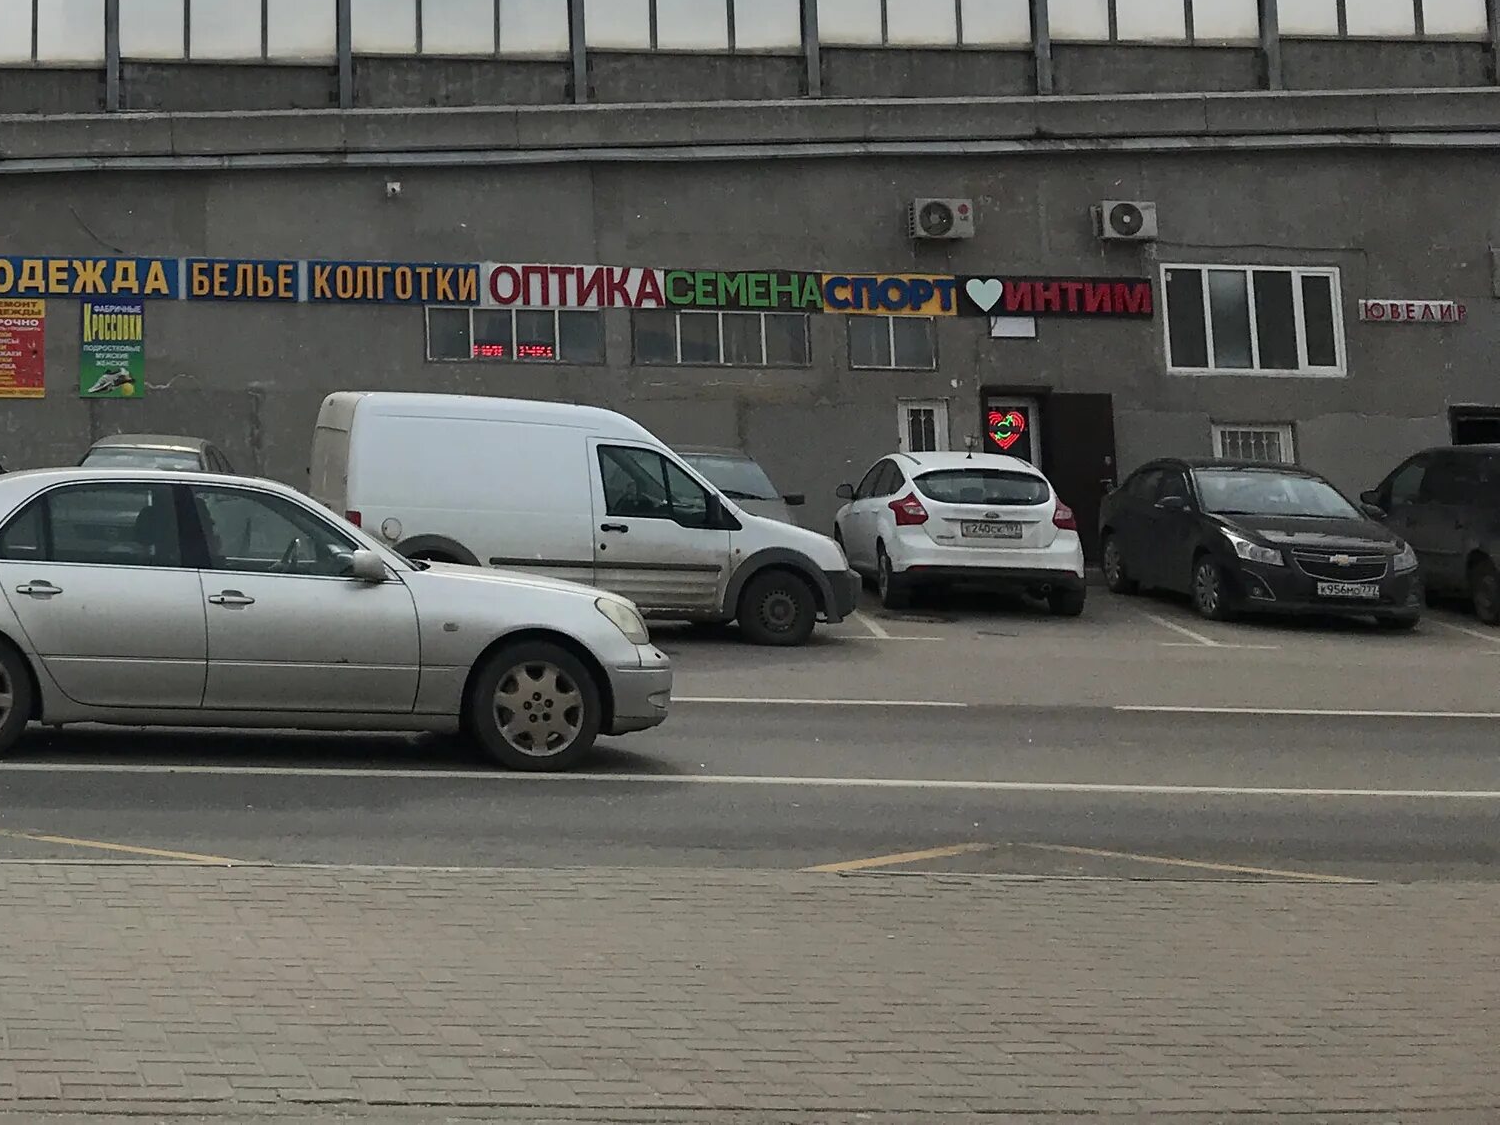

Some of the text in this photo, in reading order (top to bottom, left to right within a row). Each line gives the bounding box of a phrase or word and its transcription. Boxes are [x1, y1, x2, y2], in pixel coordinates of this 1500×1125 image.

[192, 263, 293, 298] БЕЛЬЕ
[313, 263, 477, 302] КОЛГОТКИ
[489, 265, 666, 307] ОПТИКА
[665, 270, 823, 308] СЕМЕНА
[823, 276, 958, 312] СПОРТ
[1002, 280, 1152, 313] ИНТИМ
[93, 305, 142, 313] ФАБРИЧНЫЕ
[1364, 302, 1467, 320] ЮВЕЛИР
